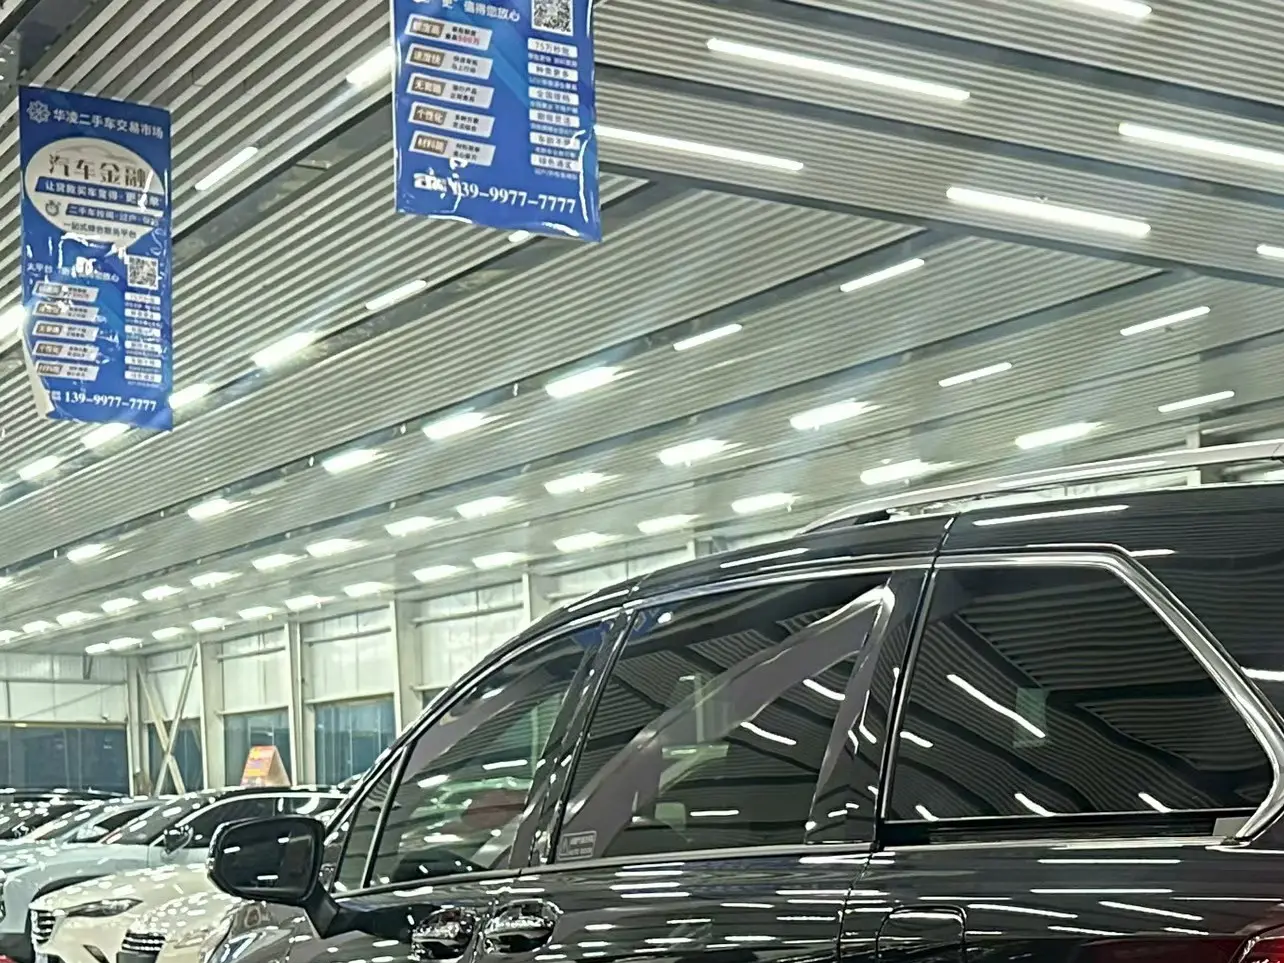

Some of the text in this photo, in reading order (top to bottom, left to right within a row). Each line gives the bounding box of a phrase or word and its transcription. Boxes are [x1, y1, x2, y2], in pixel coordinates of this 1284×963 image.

[53, 108, 164, 140] 华凌二手车交易市场
[48, 153, 149, 188] 汽车金融
